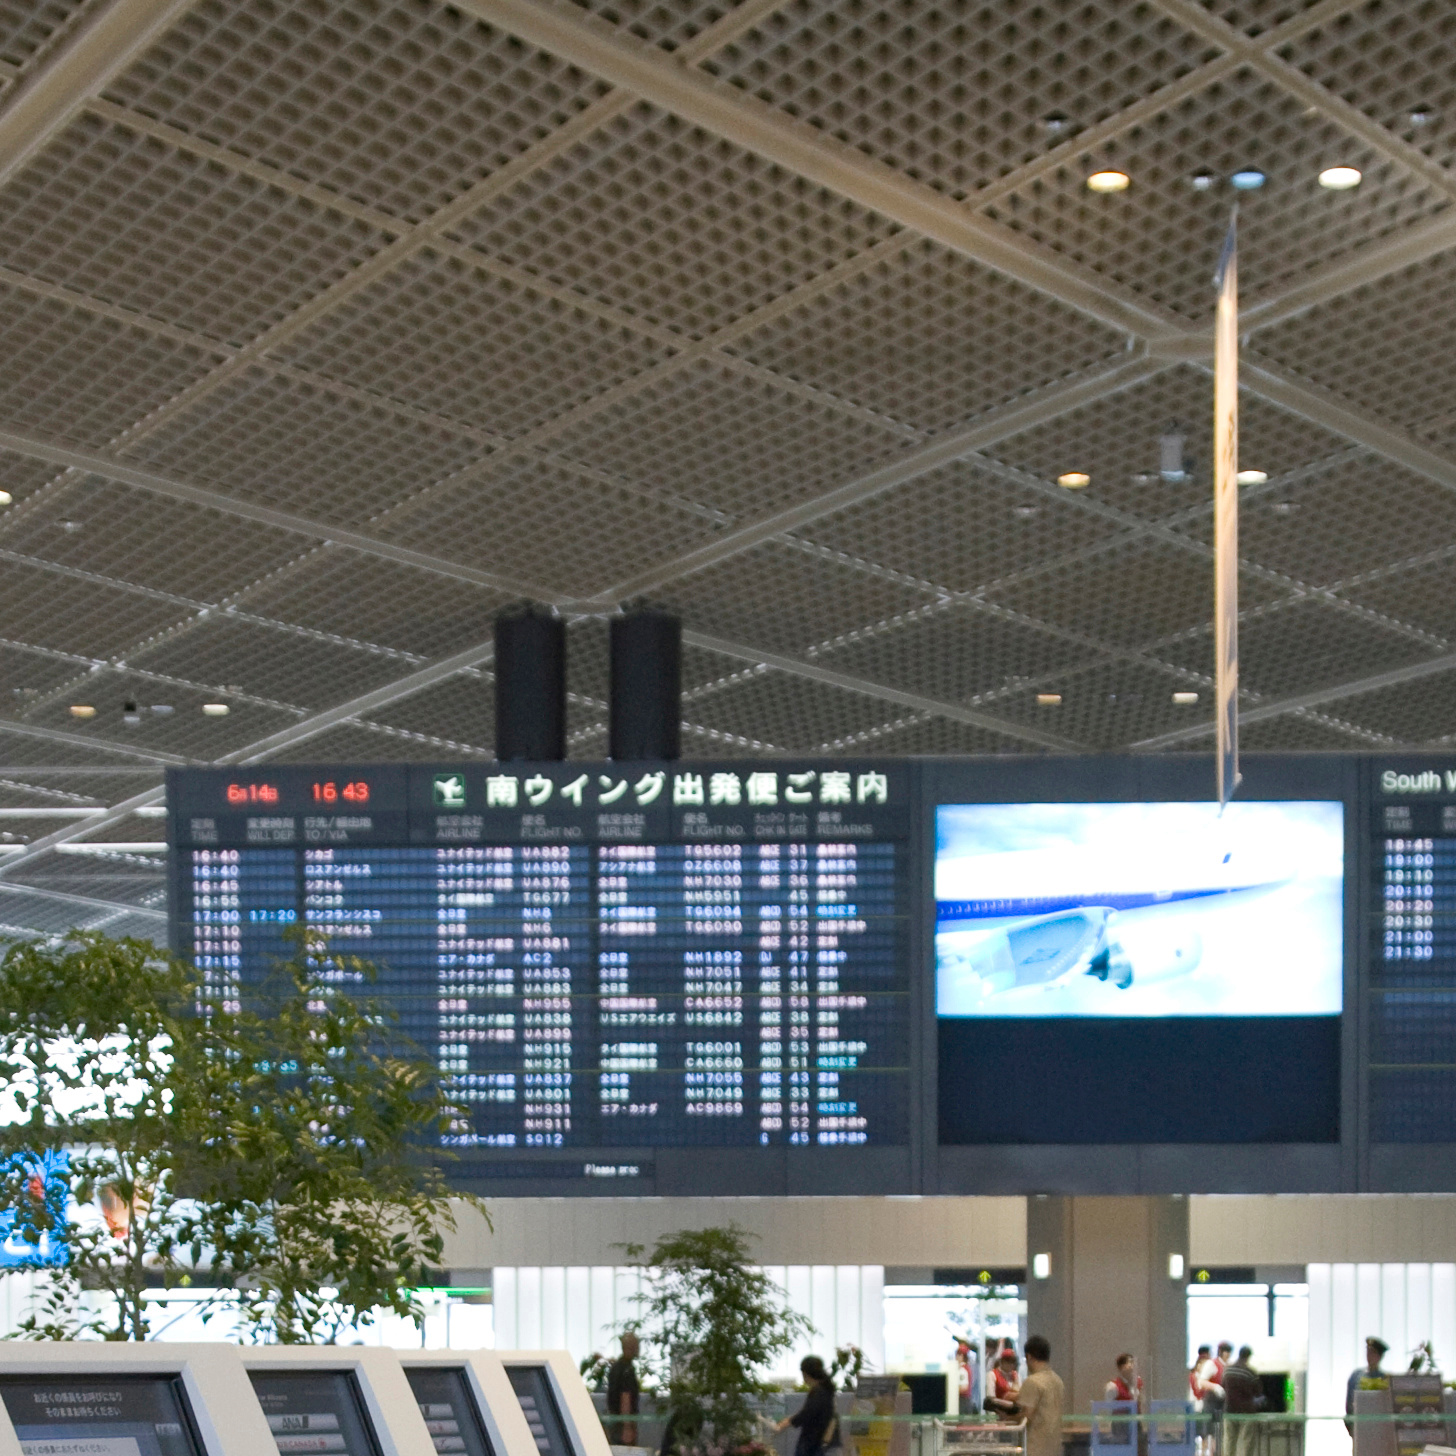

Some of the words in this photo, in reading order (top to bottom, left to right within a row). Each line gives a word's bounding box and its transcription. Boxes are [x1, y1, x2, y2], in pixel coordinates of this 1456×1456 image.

[1382, 770, 1441, 793] South
[486, 771, 887, 807] 南ウイング出発便ご案内
[436, 828, 481, 838] AIRLINE
[599, 827, 643, 837] AIRLINE
[1386, 839, 1434, 853] 18:45
[193, 850, 242, 863] 16:40
[521, 846, 572, 860] UA882
[1386, 854, 1434, 867] 19:00
[194, 866, 240, 877] 16:40
[522, 862, 571, 873] UA890
[1386, 870, 1433, 881] 19:10
[194, 881, 239, 892] 16:45
[522, 877, 571, 888] UA876
[1385, 885, 1433, 897] 20:10
[195, 896, 240, 907] 16:55
[523, 892, 570, 903] TG677
[1386, 900, 1433, 912] 20:20
[194, 911, 241, 922] 17:00
[1385, 916, 1433, 927] 20:30
[195, 926, 240, 936] 17:10
[1385, 931, 1433, 943] 21:00
[195, 941, 241, 952] 17:10
[522, 938, 569, 949] UA881
[1385, 945, 1433, 958] 21:30
[195, 956, 241, 967] 17:15
[523, 953, 552, 964] AC2
[523, 968, 571, 979] UA853
[524, 983, 571, 994] UA883
[523, 998, 571, 1009] NH955
[524, 1013, 571, 1024] UA838
[524, 1028, 571, 1039] UA899
[524, 1043, 571, 1054] NH915
[524, 1059, 570, 1069] NH921
[524, 1073, 572, 1085] UA837
[525, 1088, 570, 1100] UA801
[524, 1104, 570, 1114] NH931
[525, 1119, 570, 1129] NH911
[526, 1134, 563, 1145] SQ12
[282, 1417, 302, 1429] ANA
